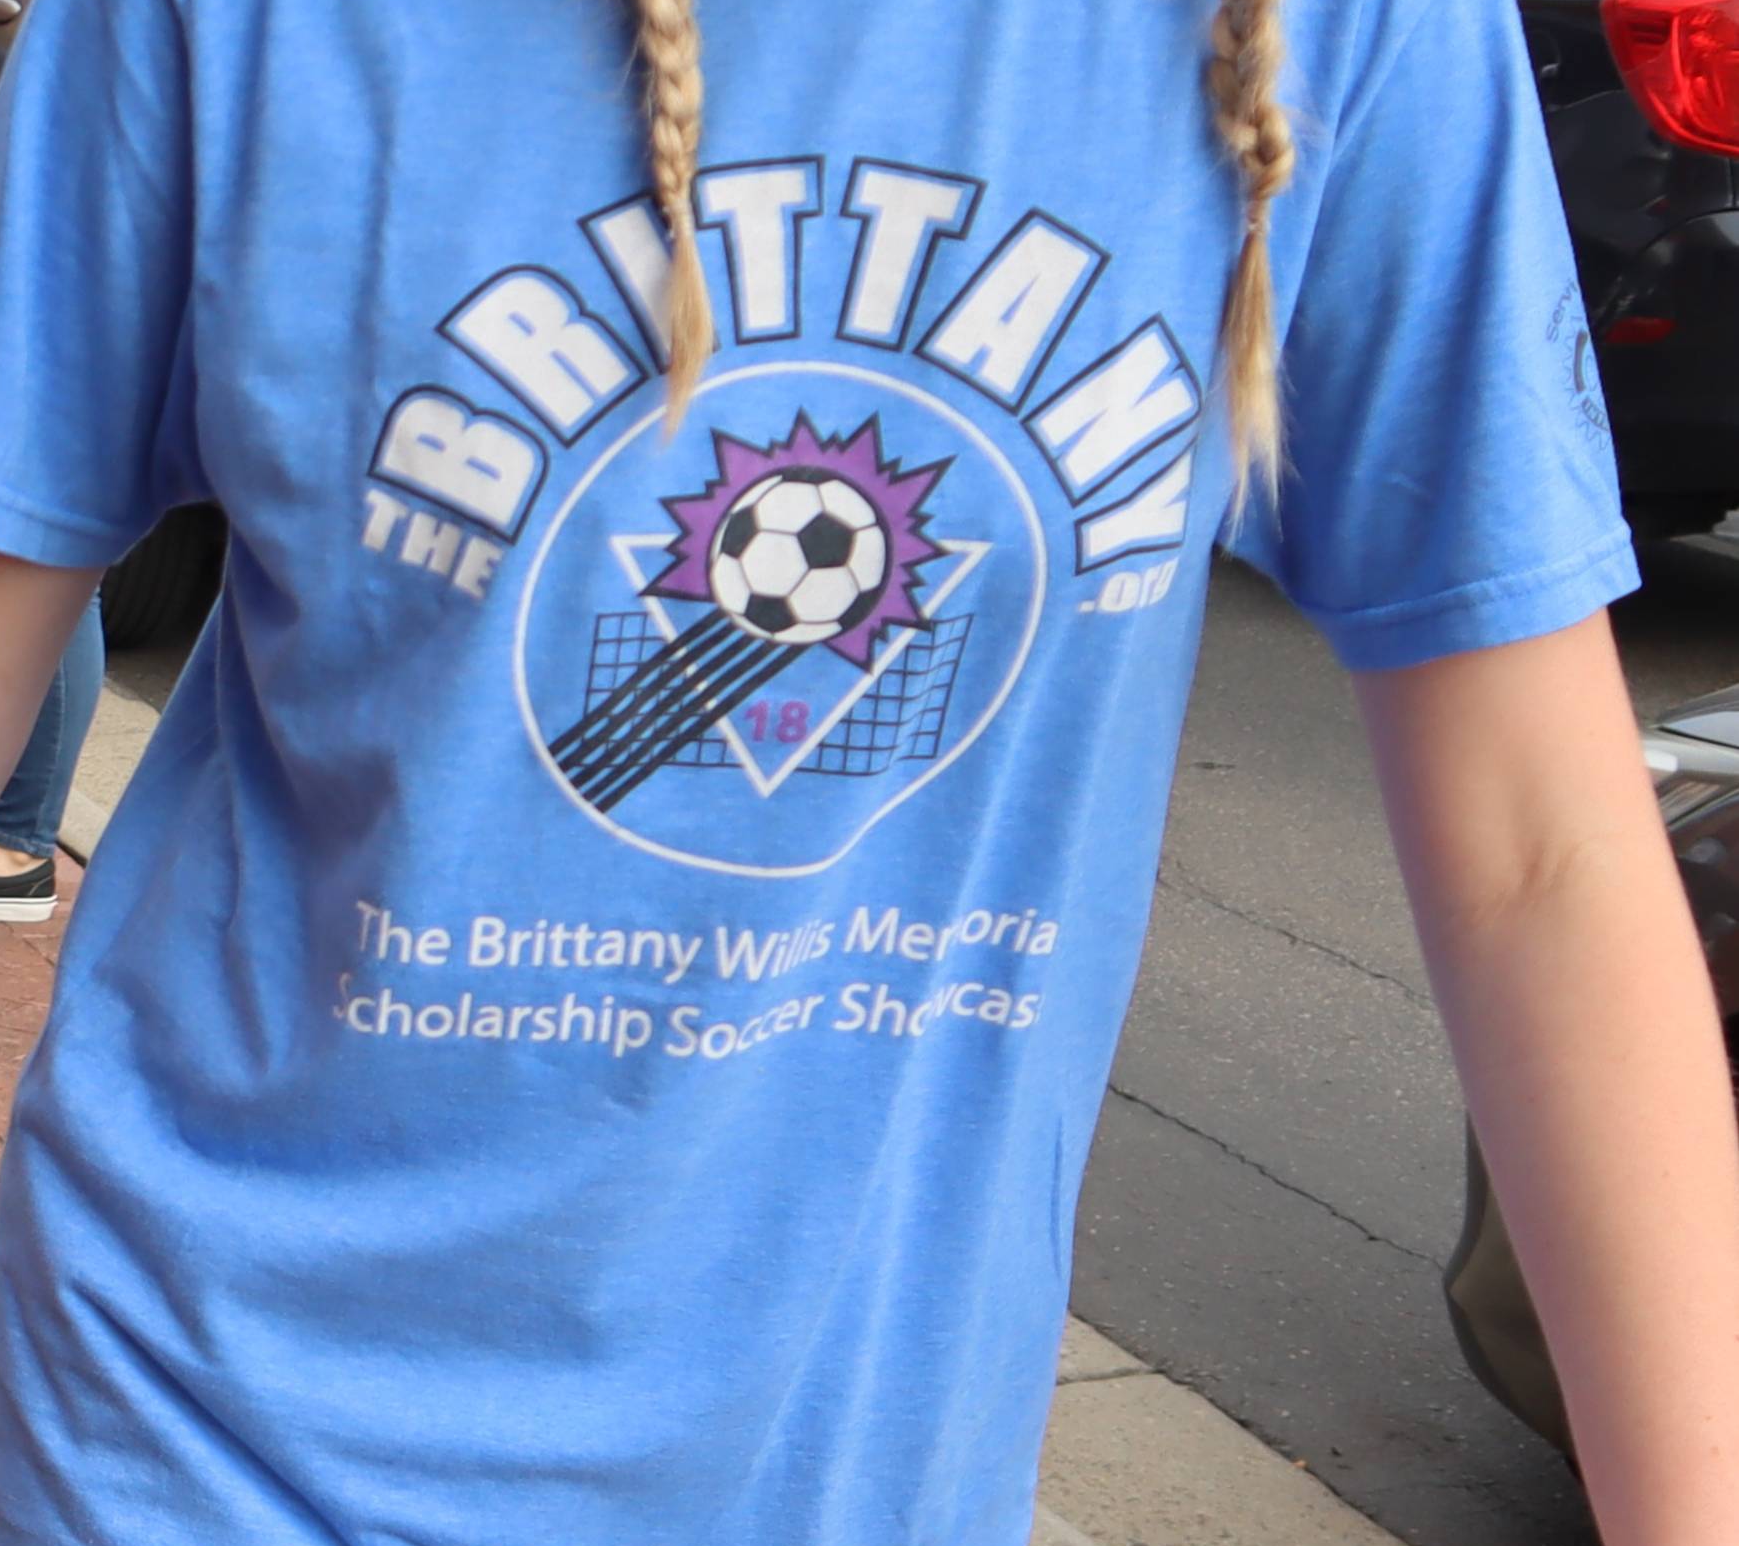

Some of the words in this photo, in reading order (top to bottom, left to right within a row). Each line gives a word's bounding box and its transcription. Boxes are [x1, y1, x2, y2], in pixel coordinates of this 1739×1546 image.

[367, 154, 1203, 577] BRITTANY
[363, 488, 505, 600] THE
[744, 699, 812, 744] 18
[356, 900, 452, 966] The
[468, 916, 704, 985] Brittany
[715, 918, 836, 982] Willis
[665, 995, 826, 1060] Soccer
